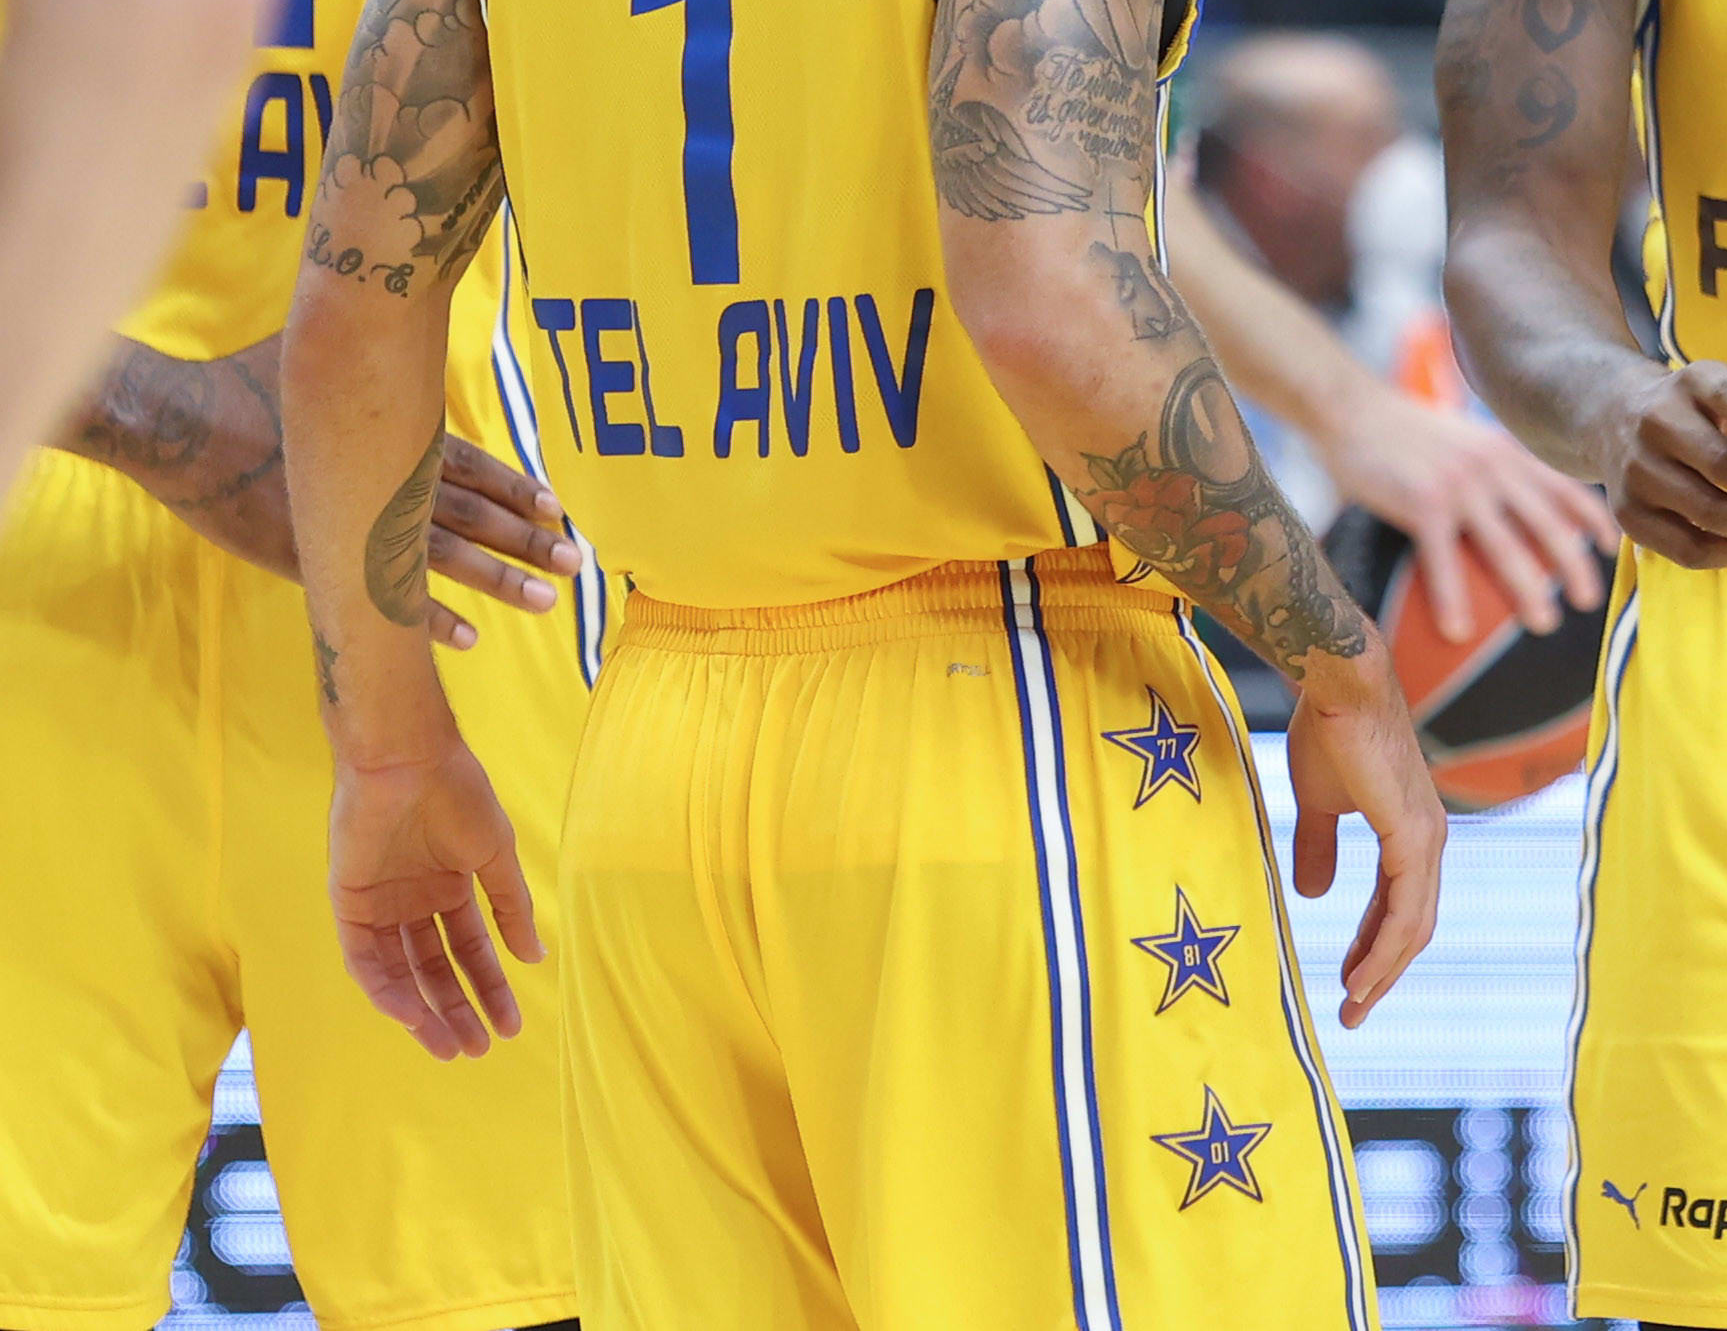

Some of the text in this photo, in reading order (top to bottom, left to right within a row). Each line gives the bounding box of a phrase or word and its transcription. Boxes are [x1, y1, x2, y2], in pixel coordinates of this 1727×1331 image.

[531, 287, 935, 459] TEL AVIV
[1157, 737, 1178, 761] 77
[1184, 942, 1202, 967] 81
